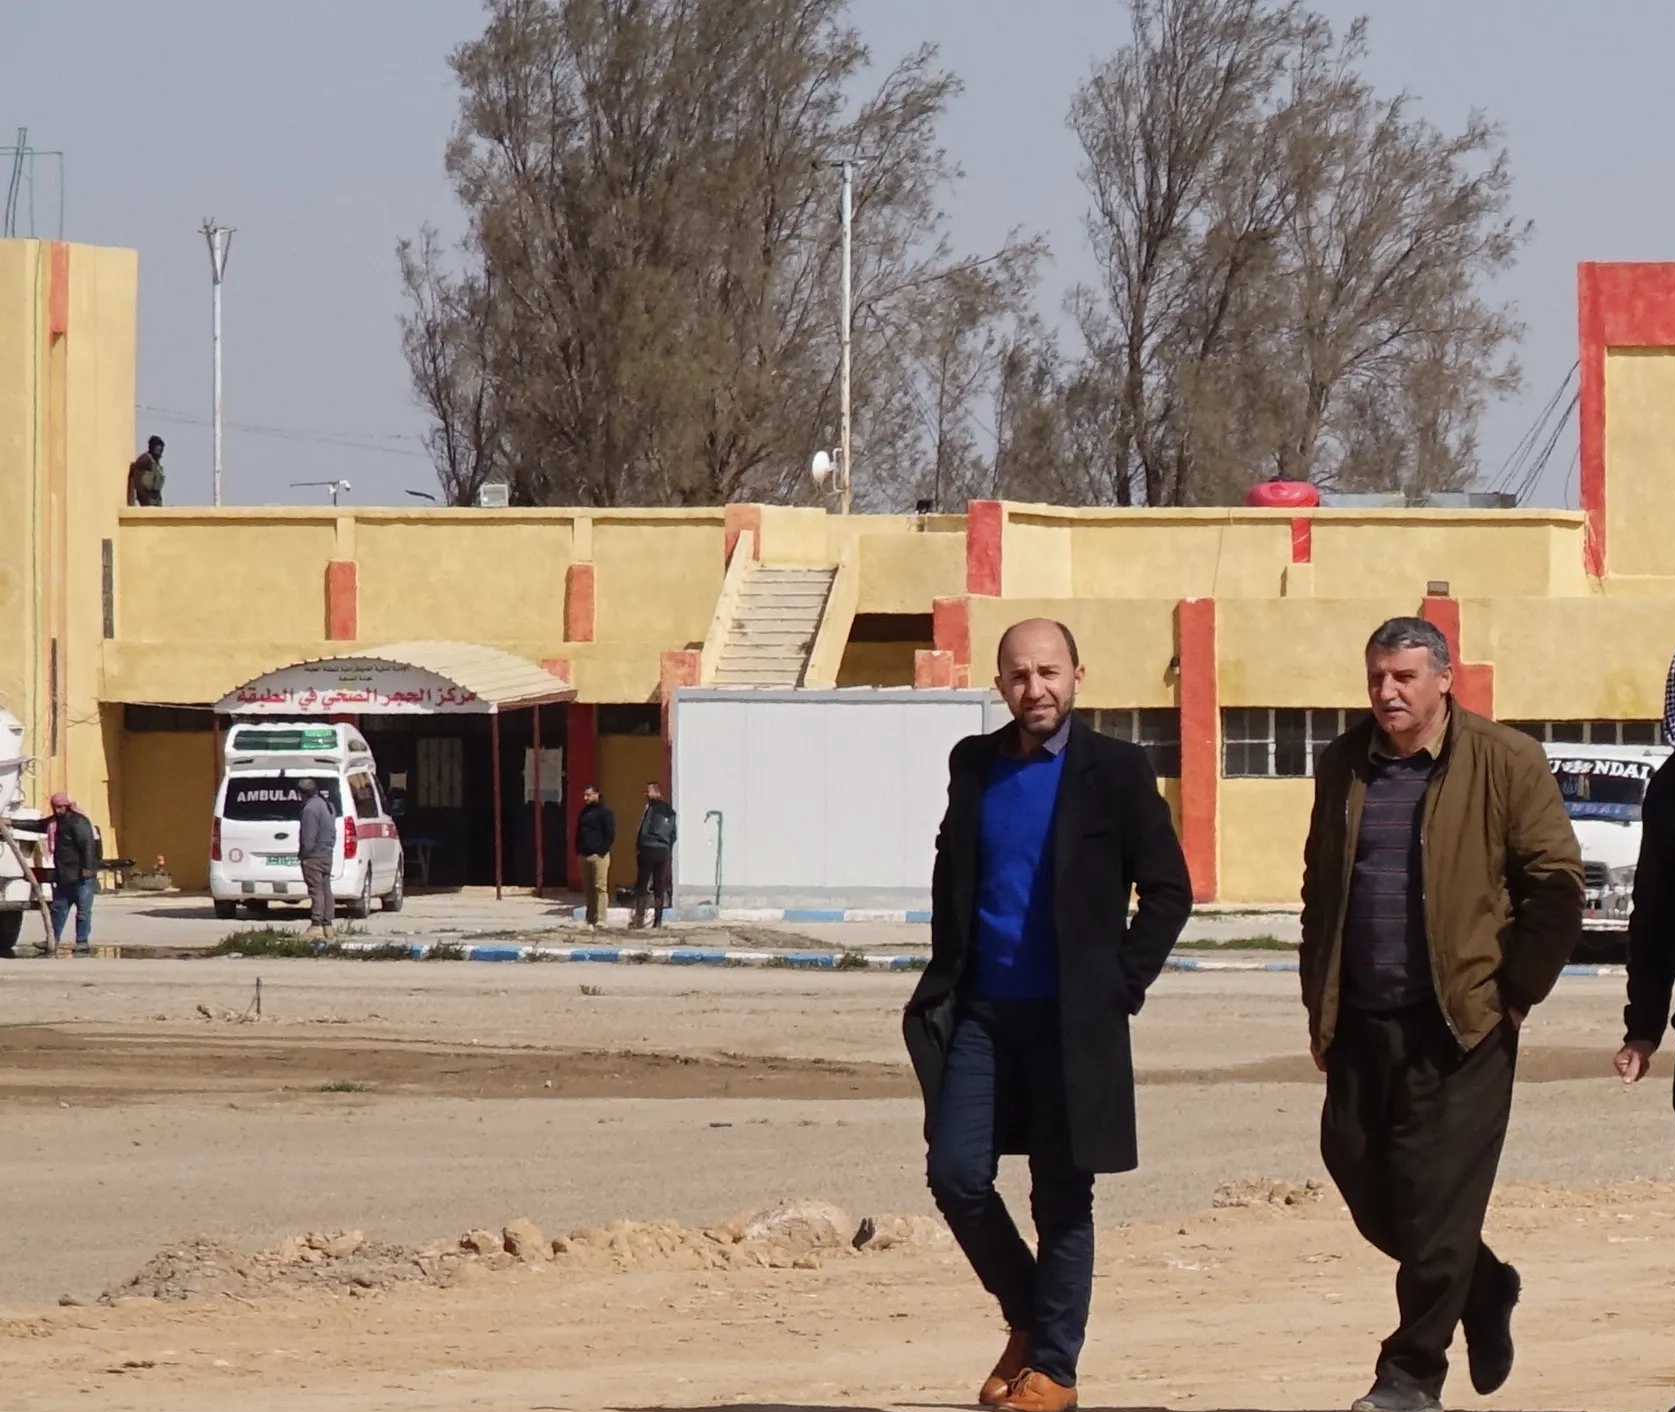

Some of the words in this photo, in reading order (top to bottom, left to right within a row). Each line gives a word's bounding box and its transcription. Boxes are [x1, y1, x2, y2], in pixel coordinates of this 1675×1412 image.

[236, 686, 294, 708] الطبقة
[299, 687, 318, 711] في
[321, 688, 378, 711] الصحي
[436, 687, 478, 707] مركز
